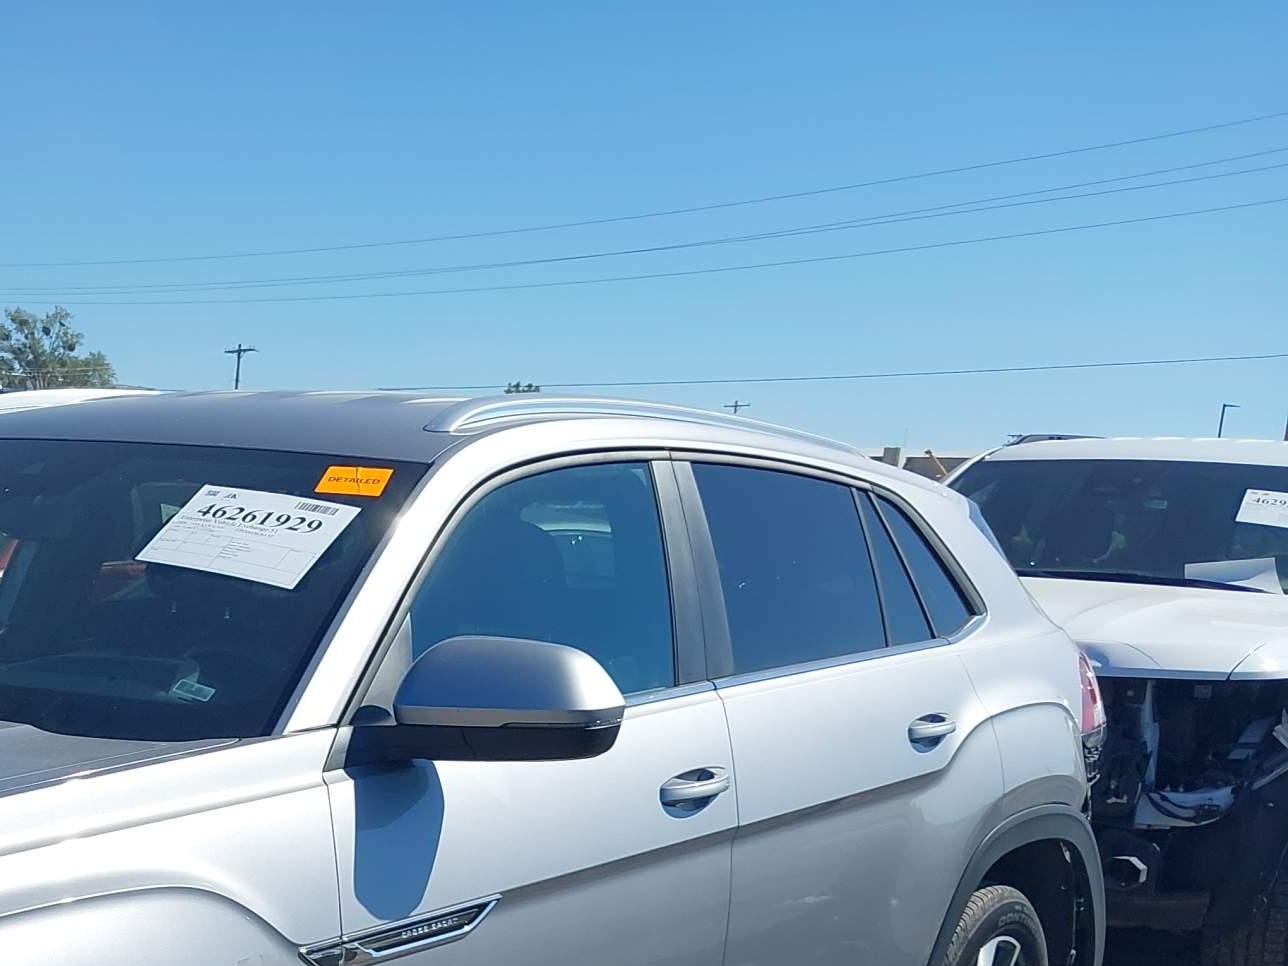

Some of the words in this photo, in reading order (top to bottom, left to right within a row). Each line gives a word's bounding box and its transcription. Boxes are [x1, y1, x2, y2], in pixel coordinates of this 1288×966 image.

[327, 476, 381, 485] DETAILED
[1252, 497, 1288, 507] 4629
[196, 503, 323, 534] 46261929
